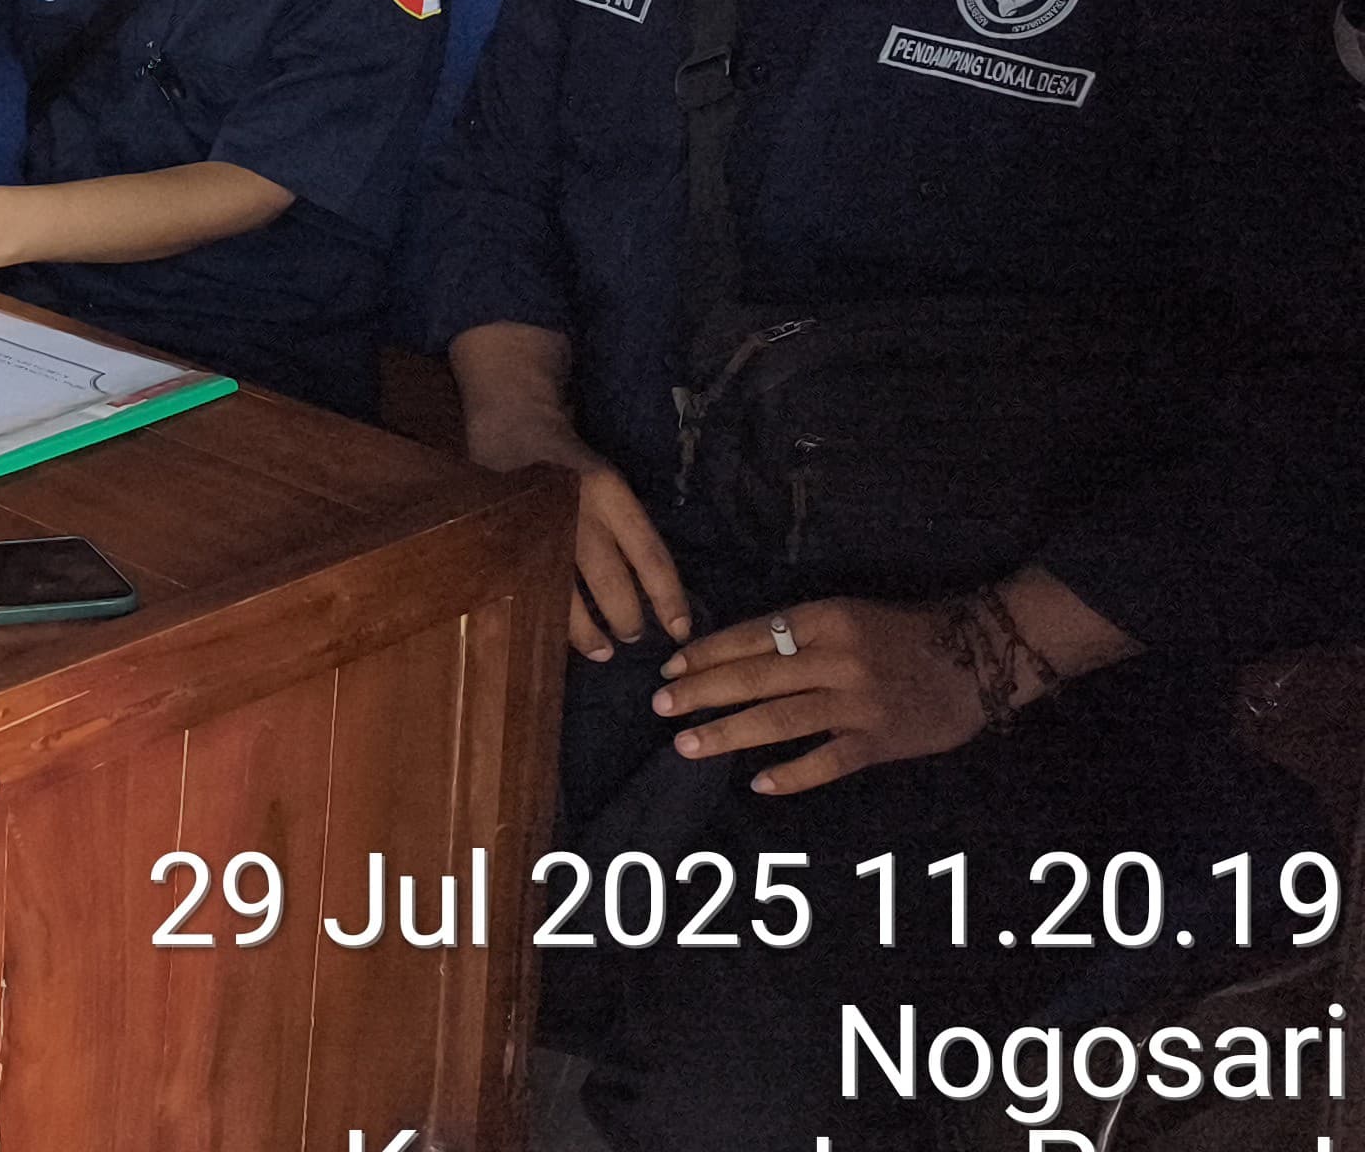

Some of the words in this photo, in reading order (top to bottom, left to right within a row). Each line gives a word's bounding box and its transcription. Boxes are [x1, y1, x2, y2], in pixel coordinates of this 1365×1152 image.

[892, 38, 984, 76] PENDAMPING
[984, 57, 1036, 90] LOKAL
[1036, 74, 1078, 96] DESA
